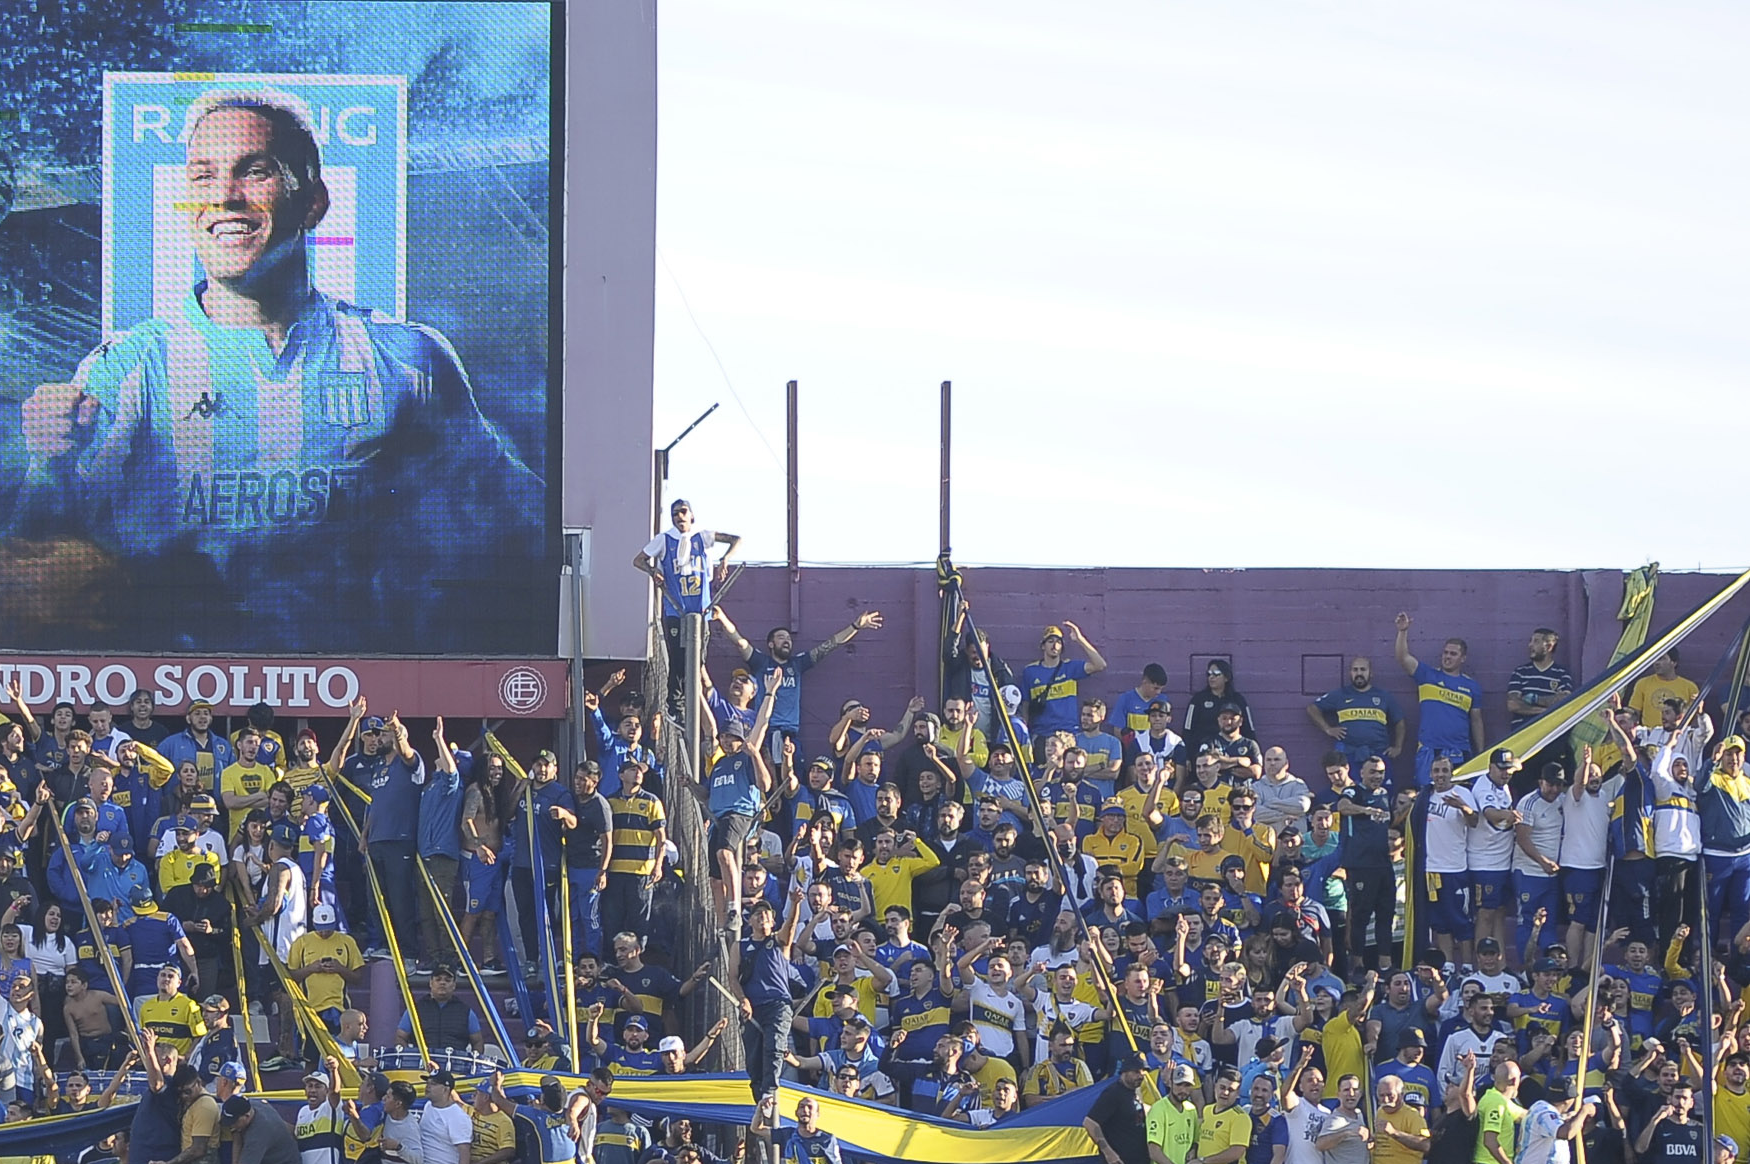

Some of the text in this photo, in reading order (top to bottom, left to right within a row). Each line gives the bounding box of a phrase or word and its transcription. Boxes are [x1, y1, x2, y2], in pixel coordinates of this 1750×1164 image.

[679, 576, 702, 596] 12
[154, 664, 360, 708] SOLITO
[1439, 690, 1463, 701] QATAR
[714, 773, 734, 787] BBVA
[905, 1015, 929, 1026] QATAR
[984, 1011, 1009, 1024] QATAR
[1667, 1143, 1697, 1156] BBVA
